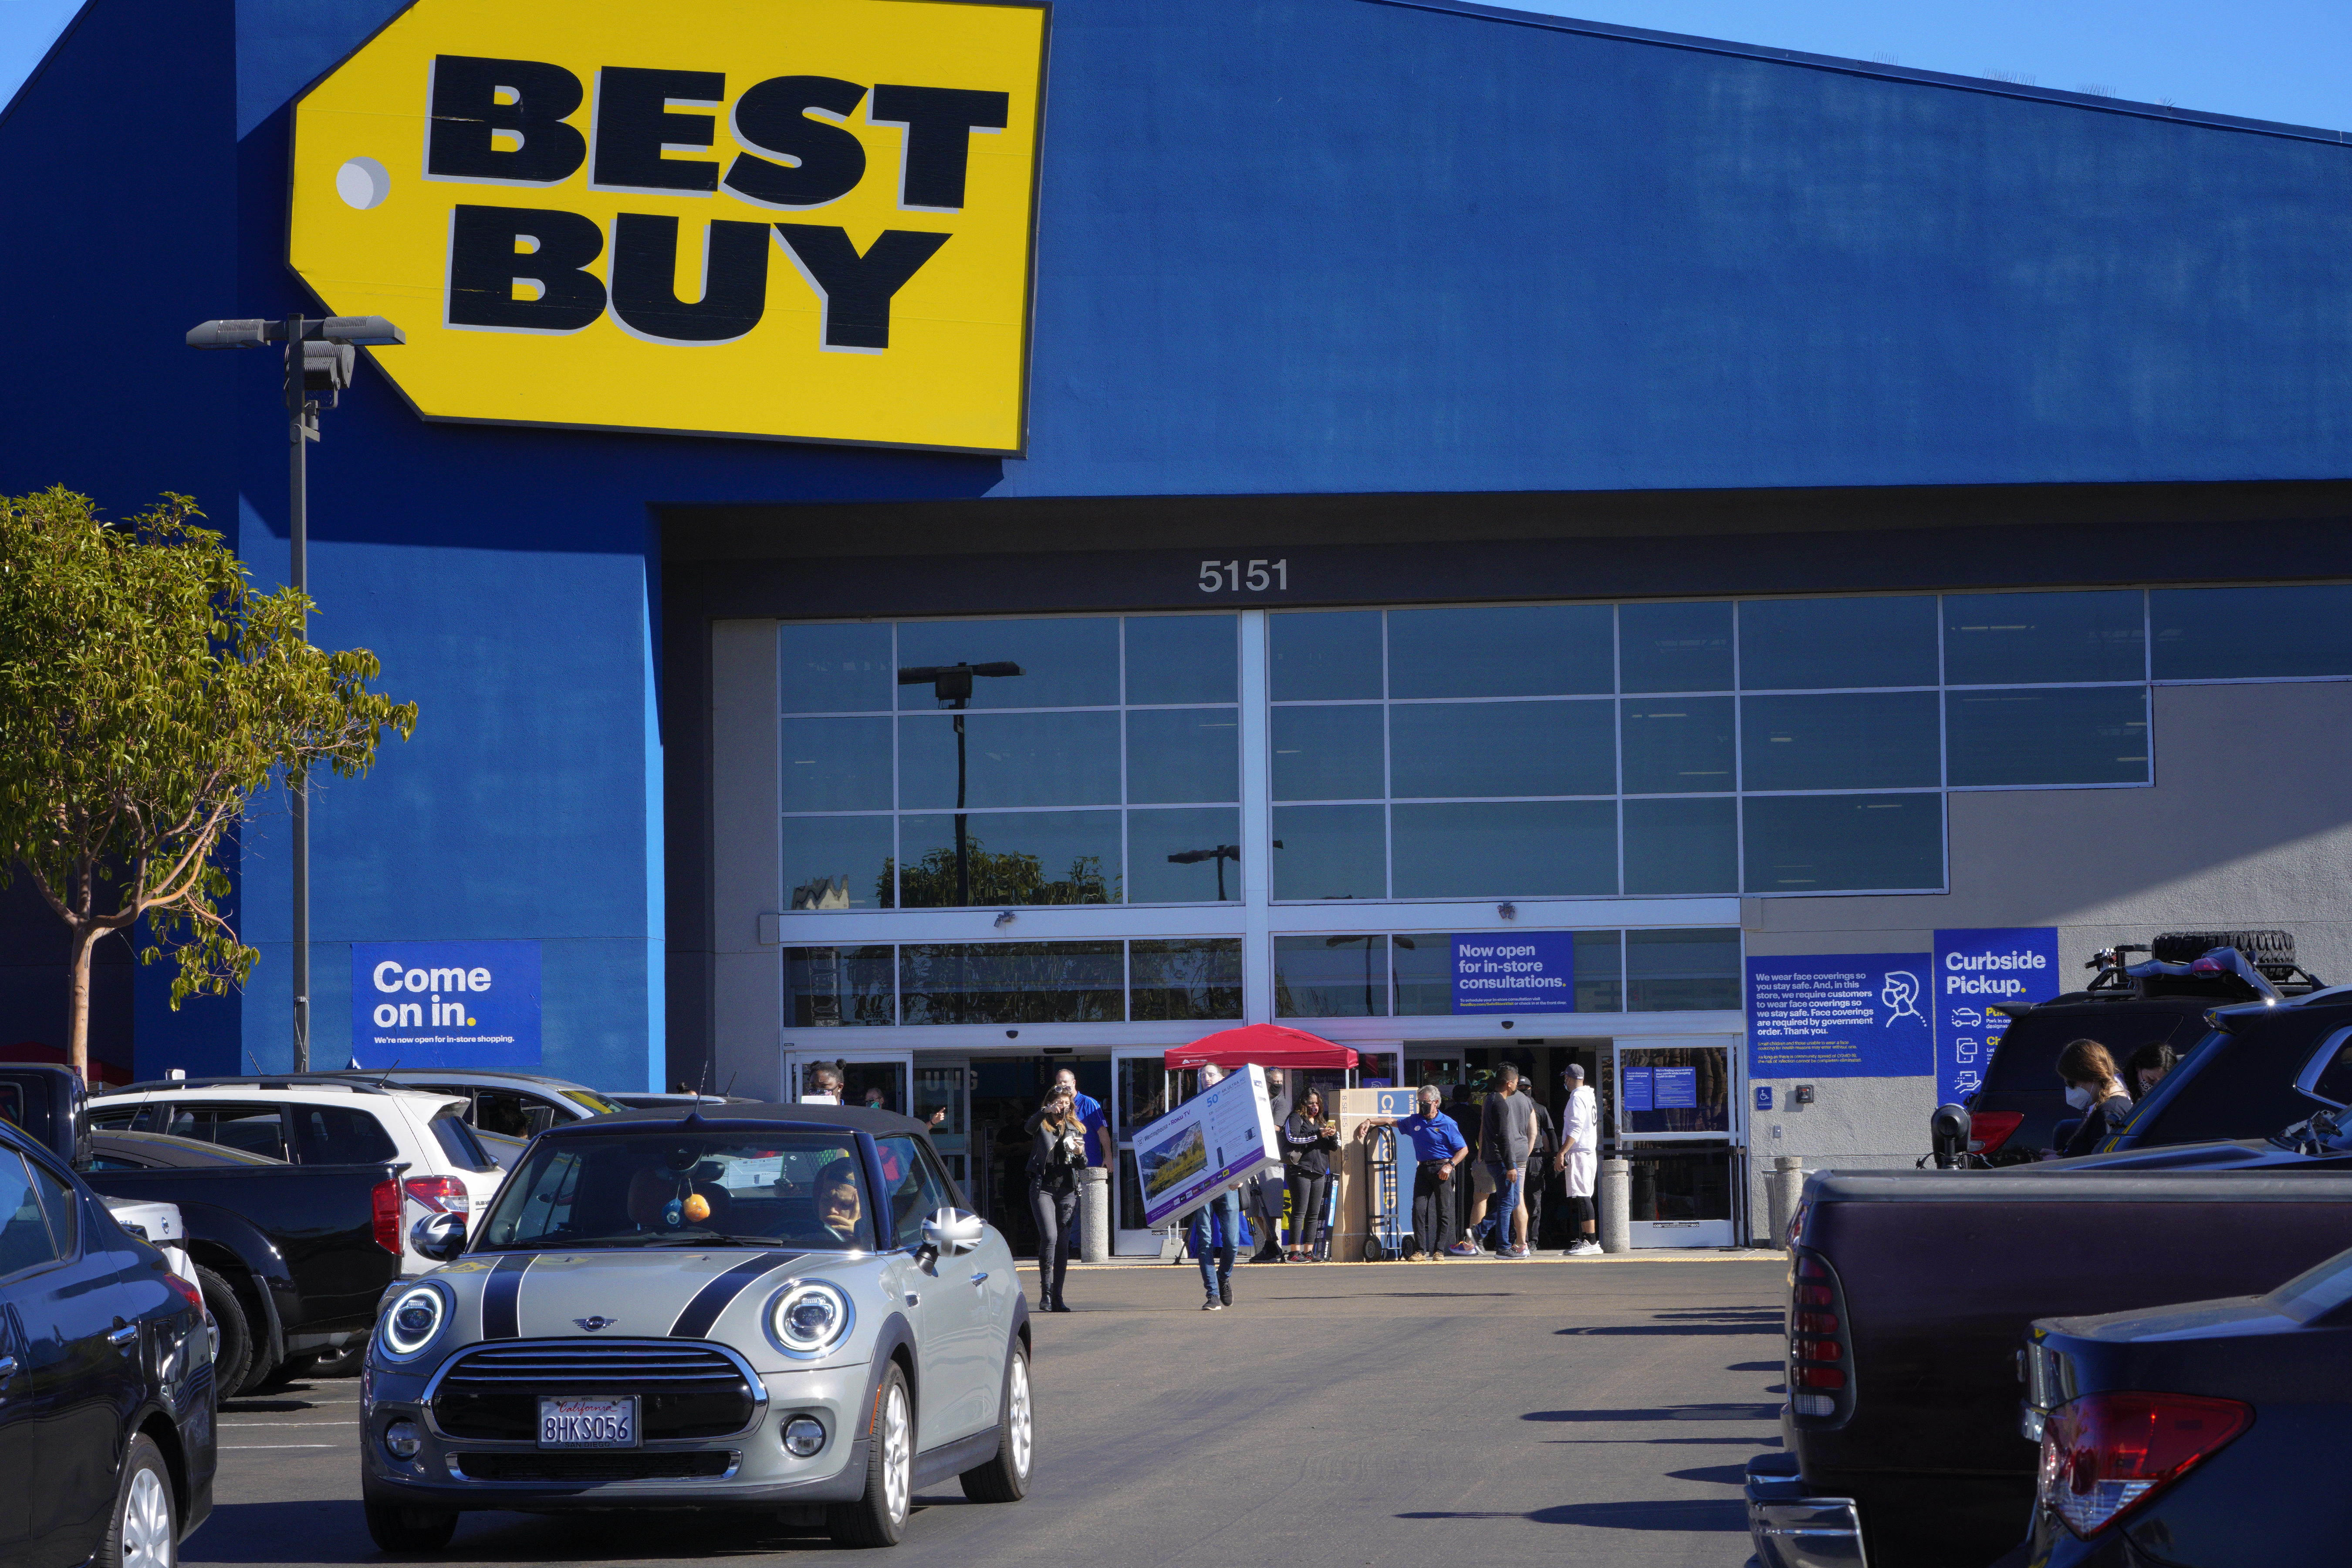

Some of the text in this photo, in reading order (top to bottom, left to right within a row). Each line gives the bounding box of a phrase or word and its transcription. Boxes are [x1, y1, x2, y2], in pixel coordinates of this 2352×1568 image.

[422, 54, 1010, 212] BEST
[442, 203, 954, 356] BUY
[1198, 559, 1287, 592] 5151
[1459, 944, 1535, 959] Now open
[1459, 960, 1543, 973] for in-store
[1946, 950, 2046, 970] Curbside
[373, 961, 491, 993] Come
[1459, 974, 1566, 989] consultations.
[1813, 972, 1854, 981] coverings
[1792, 981, 1812, 990] safe.
[1813, 981, 1833, 990] And,
[1947, 975, 2026, 997] Pickup.
[1796, 991, 1826, 999] require
[373, 994, 476, 1027] on in.
[1808, 1000, 1850, 1008] coverings
[1771, 1010, 1788, 1018] stay
[1832, 1008, 1874, 1017] coverings
[1986, 1007, 2005, 1017] Pu
[1772, 1018, 1808, 1027] required
[1810, 1019, 1820, 1027] by
[1821, 1017, 1873, 1026] government
[415, 1036, 434, 1044] open
[477, 1035, 515, 1043] shopping.
[1227, 1081, 1240, 1091] ULTRA
[1144, 1109, 1190, 1142] Westinghouse Roku TV
[559, 1402, 618, 1416] California
[545, 1416, 629, 1440] 8HKS056
